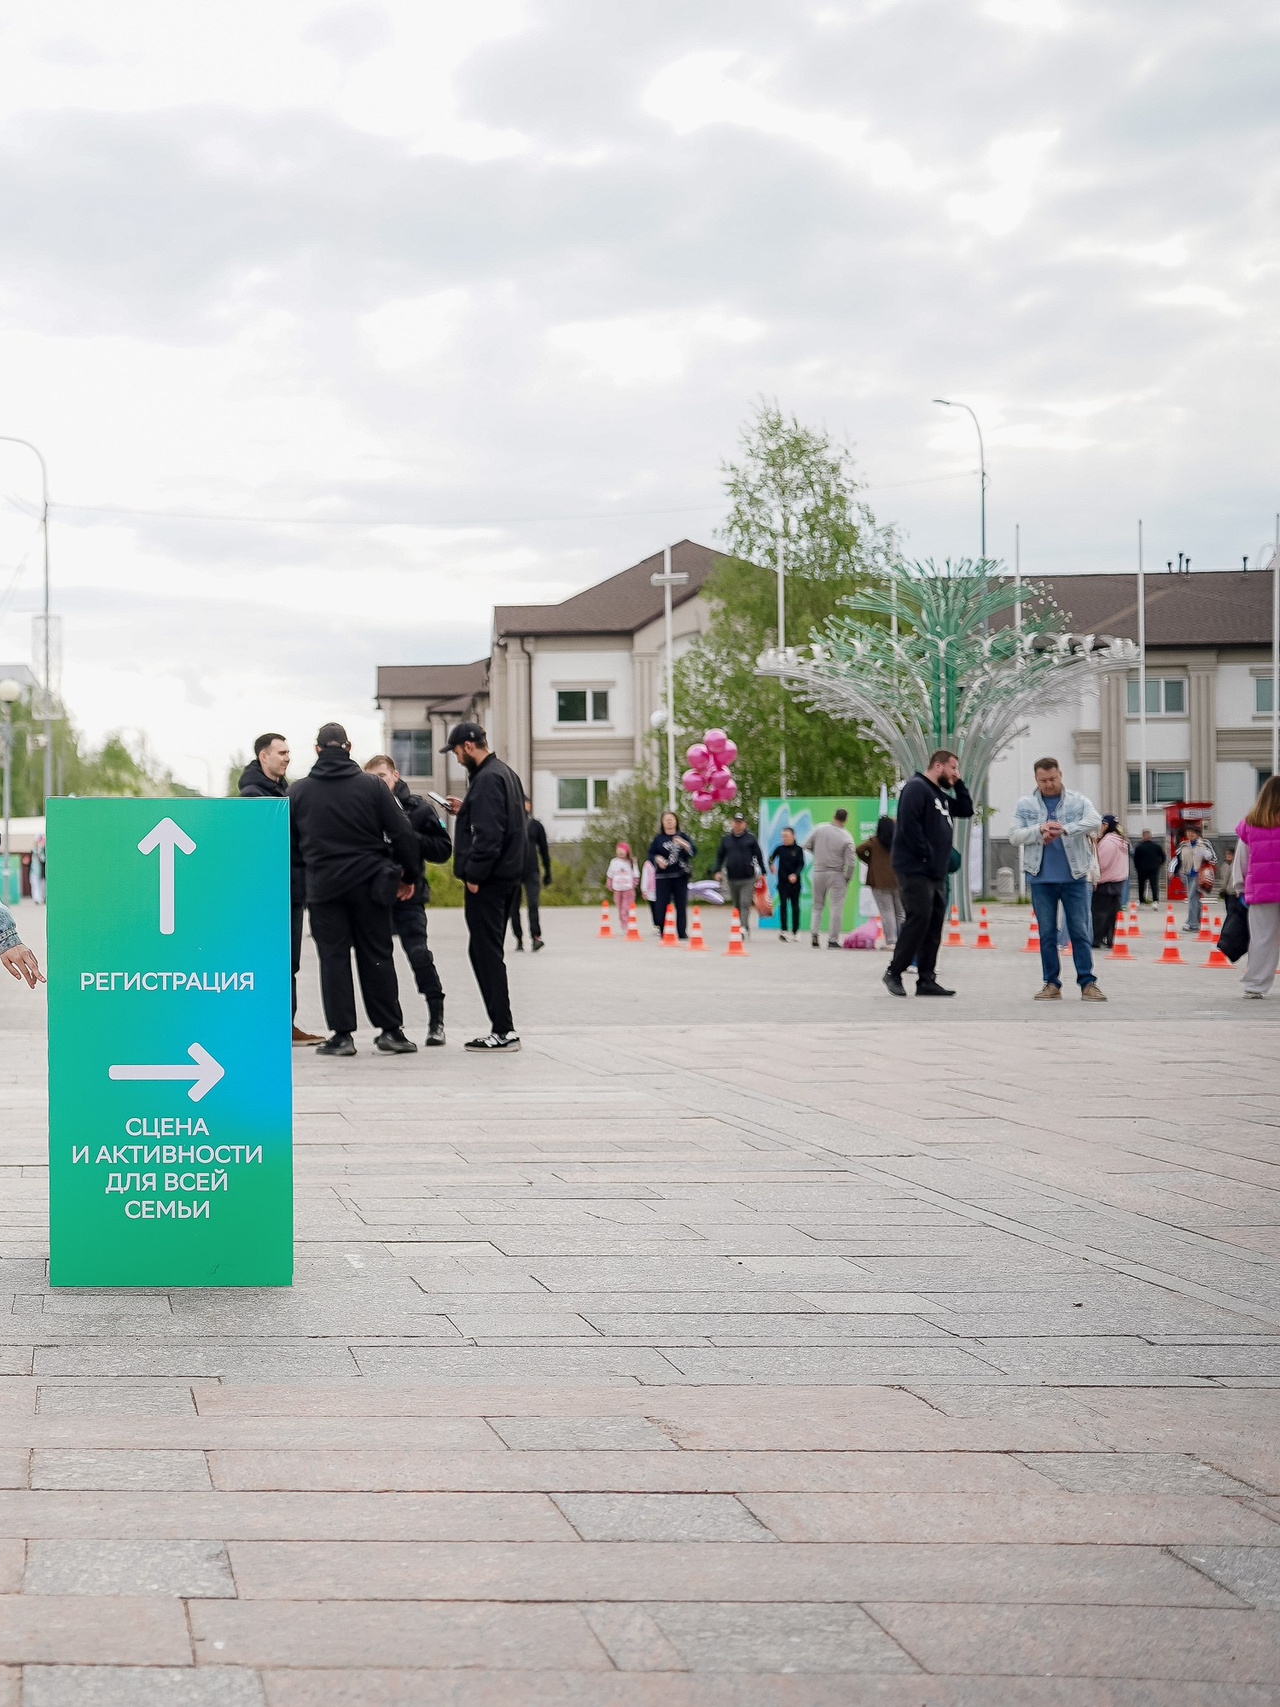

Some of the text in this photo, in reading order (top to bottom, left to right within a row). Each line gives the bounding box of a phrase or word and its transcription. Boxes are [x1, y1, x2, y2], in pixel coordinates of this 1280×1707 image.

[80, 972, 254, 993] РЕГИСТРАЦИЯ
[125, 1117, 210, 1138] СЦЕНА
[72, 1145, 262, 1164] И АКТИВНОСТИ
[105, 1168, 228, 1194] ДЛЯ ВСЕЙ
[124, 1200, 210, 1219] СЕМЬИ
